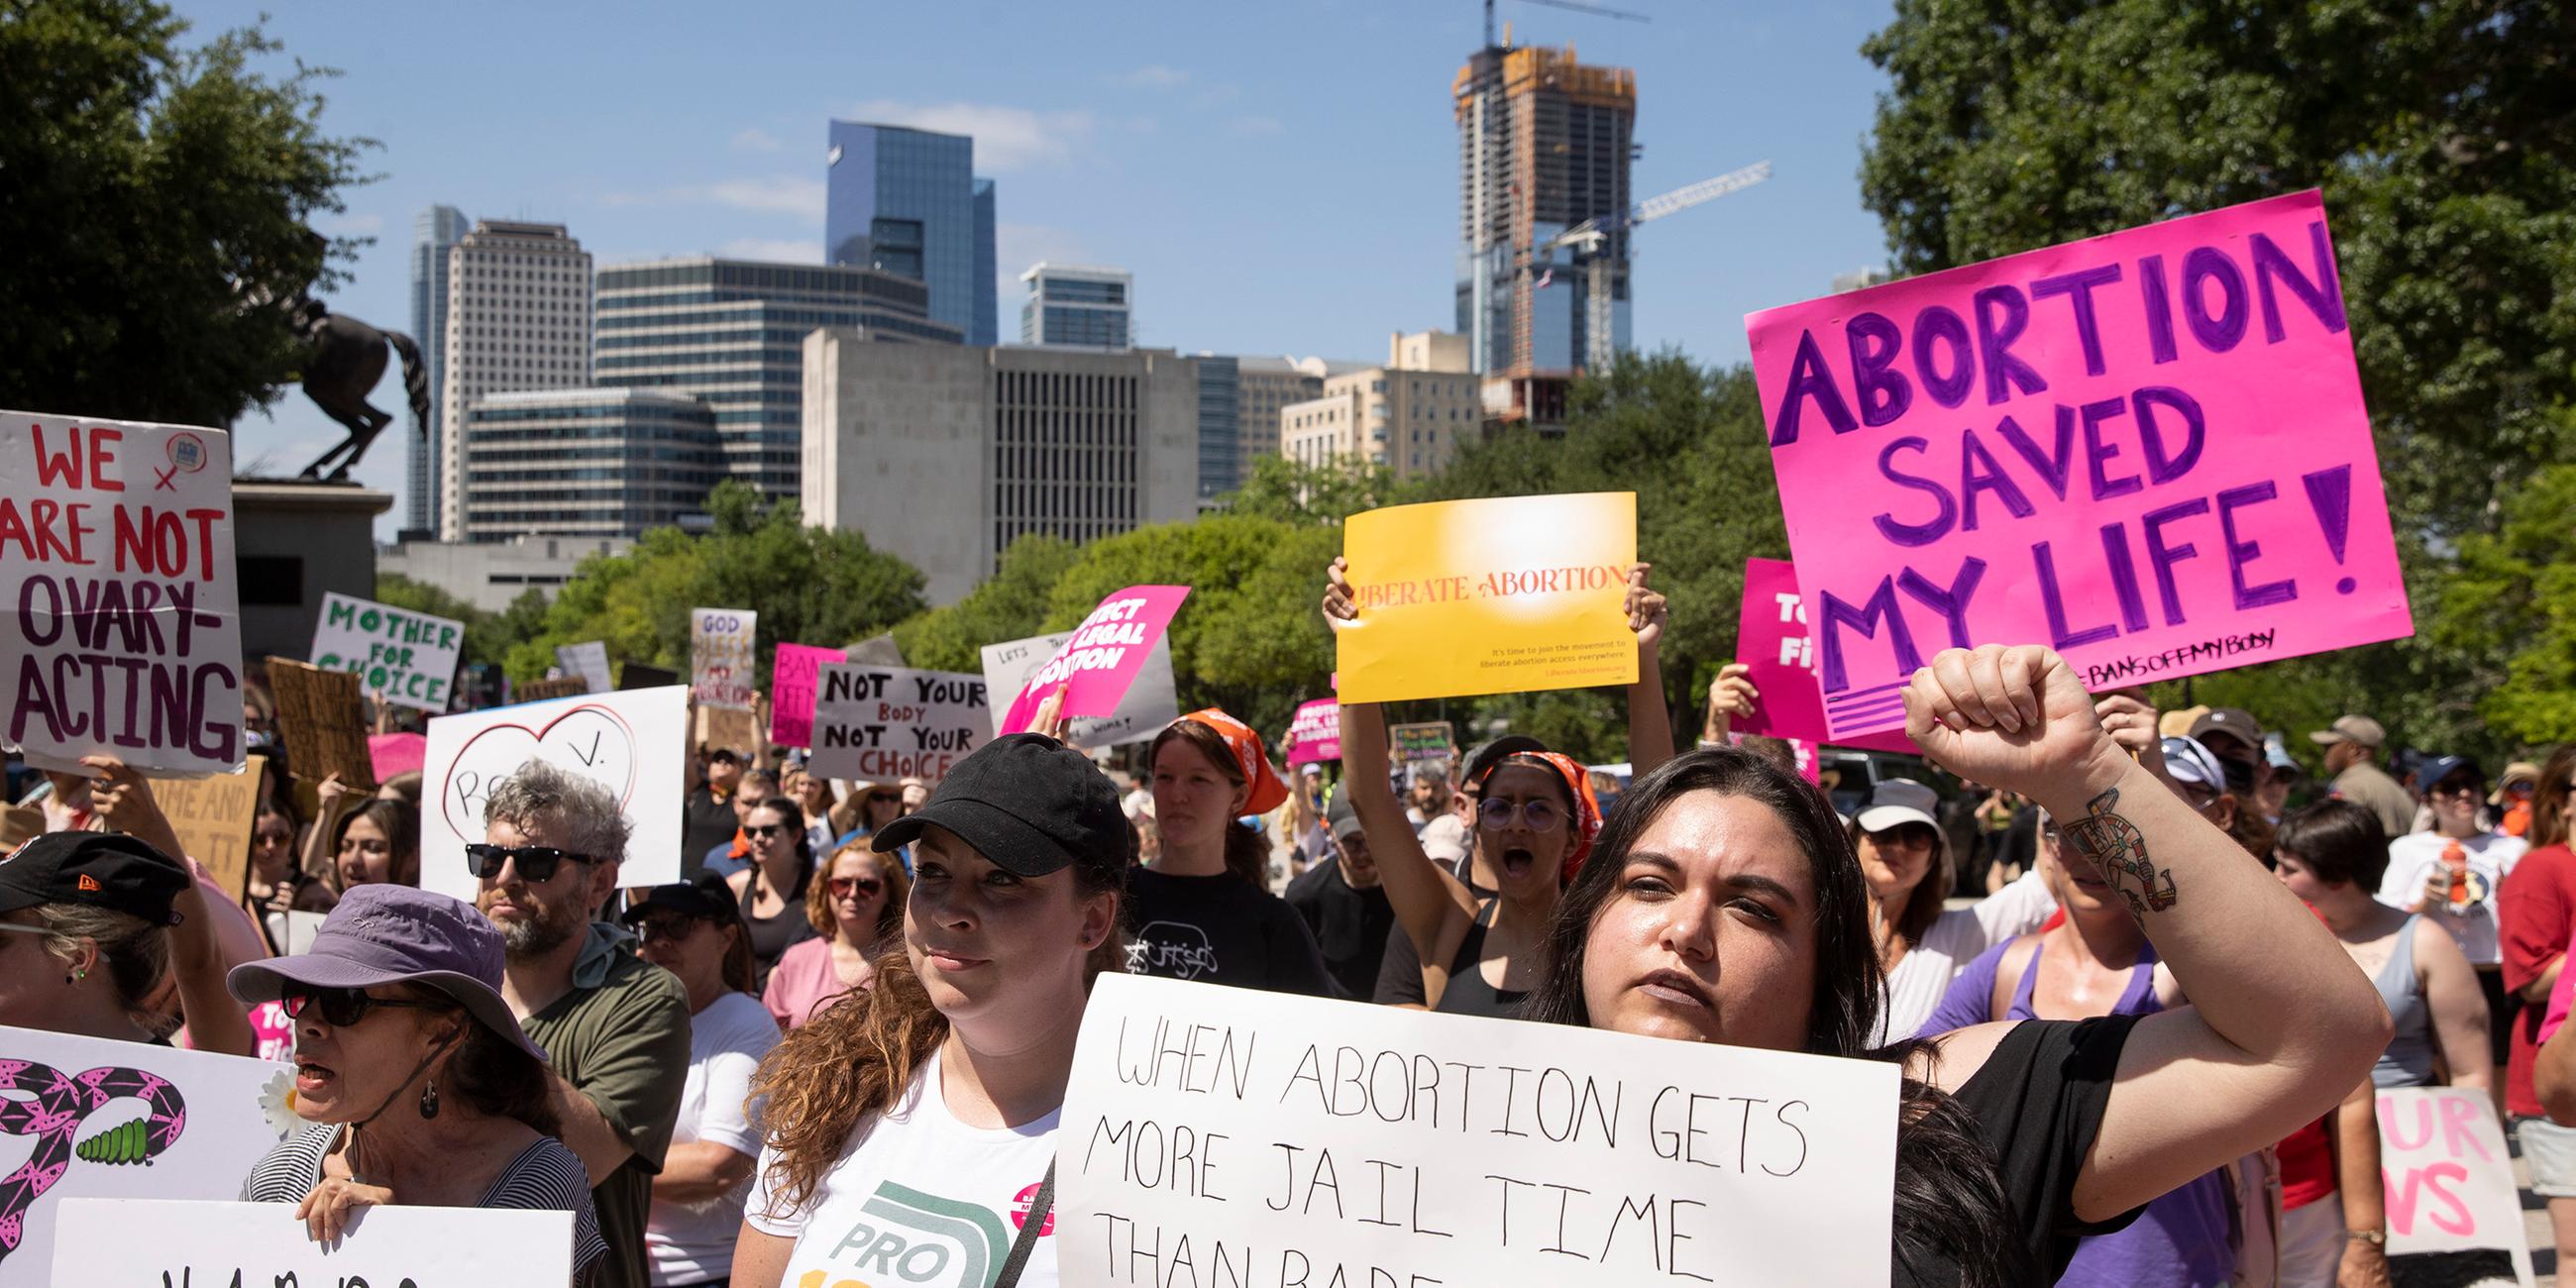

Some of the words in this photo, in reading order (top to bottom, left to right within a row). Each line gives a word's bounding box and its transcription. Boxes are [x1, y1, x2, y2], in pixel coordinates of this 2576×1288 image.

[1771, 221, 2348, 447] ABORTION
[32, 423, 126, 492] WE
[1874, 385, 2205, 547] SAVED
[0, 497, 96, 566] ARE
[114, 502, 226, 582] NOT
[1477, 565, 1629, 598] ABORTION
[18, 574, 223, 658] OVARY-
[327, 599, 458, 651] MOTHER
[703, 614, 739, 633] GOD
[1073, 622, 1147, 649] LEGAL
[1819, 555, 1986, 695] MY
[370, 642, 414, 668] FOR
[780, 650, 819, 681] BAN
[9, 653, 238, 764] ACTING
[824, 670, 893, 702] NOT
[915, 677, 988, 708] YOUR
[878, 701, 926, 724] BODY
[824, 724, 887, 748] NOT
[912, 726, 974, 752] YOUR
[860, 749, 953, 780] CHOICE
[200, 784, 248, 823] AND
[206, 833, 242, 872] IT
[1115, 1015, 1257, 1102] WHEN
[1279, 1043, 1622, 1148] ABORTION
[1649, 1085, 1810, 1178] GETS
[1083, 1114, 1231, 1204] MORE
[1265, 1142, 1453, 1238] JAIL
[1484, 1174, 1715, 1284] TIME
[828, 1223, 950, 1283] PRO
[1093, 1212, 1251, 1288] THAN
